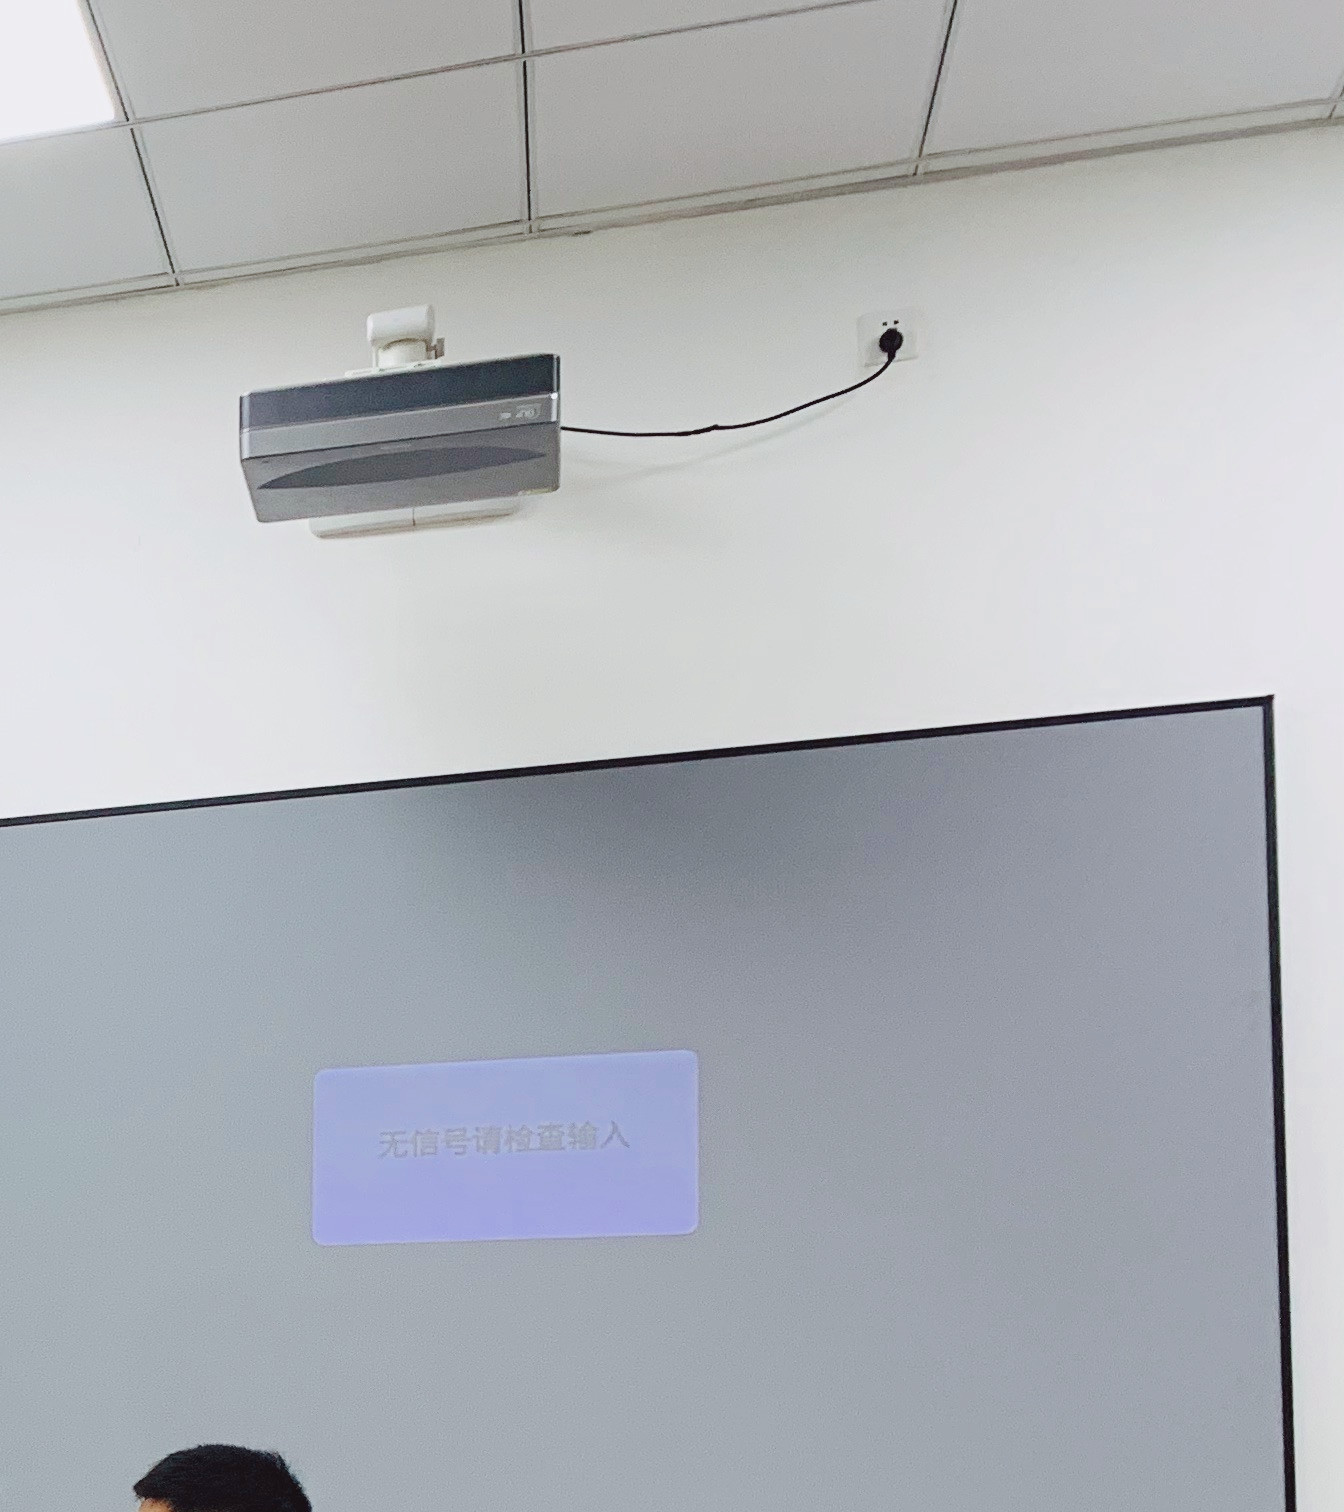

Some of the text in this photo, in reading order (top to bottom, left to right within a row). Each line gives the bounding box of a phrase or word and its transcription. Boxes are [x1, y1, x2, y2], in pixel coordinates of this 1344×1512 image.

[378, 1120, 631, 1158] 无信号请检查输入
